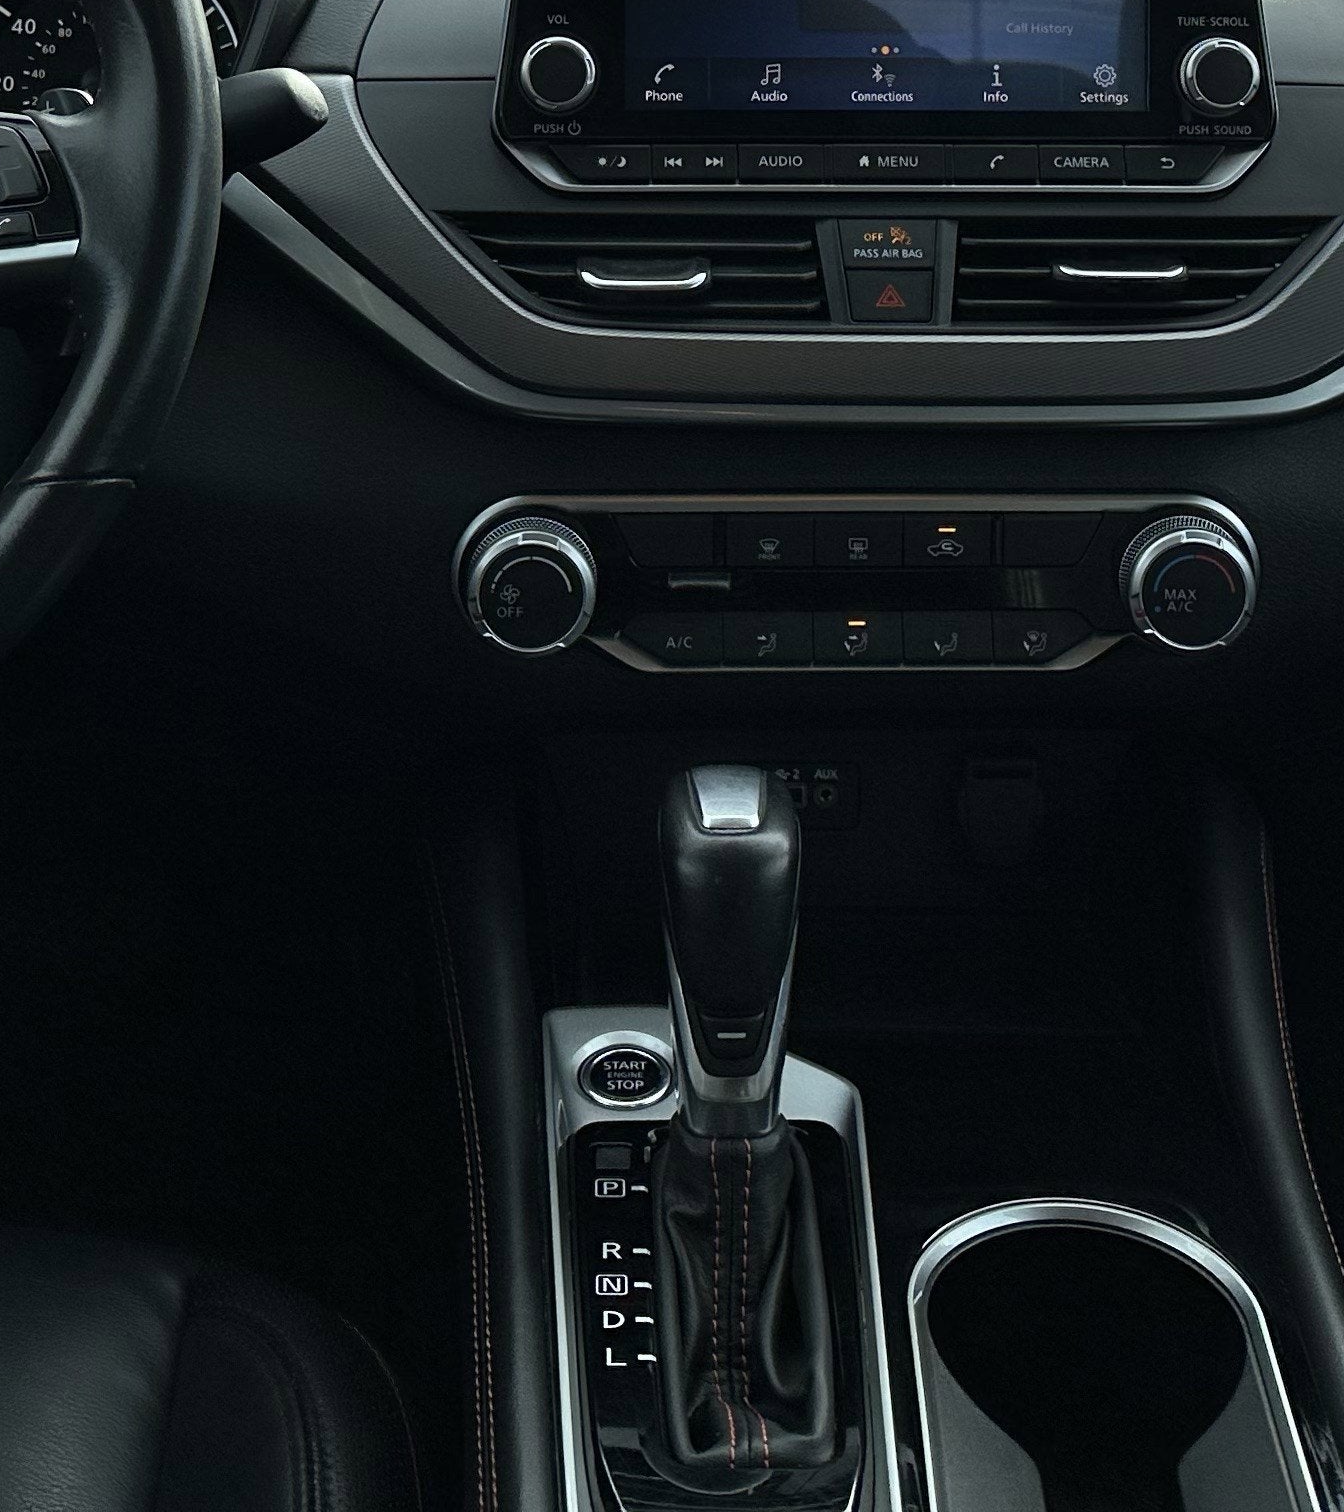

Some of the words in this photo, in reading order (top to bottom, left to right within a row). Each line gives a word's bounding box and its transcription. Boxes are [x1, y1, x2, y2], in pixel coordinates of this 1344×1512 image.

[547, 14, 570, 26] VOL
[10, 18, 37, 35] 40
[57, 27, 73, 38] 80
[1005, 22, 1031, 35] Call
[1033, 22, 1074, 37] History
[41, 44, 56, 54] 60
[31, 69, 45, 79] 40
[644, 90, 683, 103] Phone
[750, 90, 788, 103] Audio
[850, 90, 914, 104] Connections
[983, 91, 1009, 103] Info
[1079, 91, 1129, 106] Settings
[533, 122, 564, 134] PUSH
[1178, 125, 1209, 136] PUSH
[1213, 125, 1251, 136] SOUND
[757, 155, 803, 168] AUDIO
[877, 155, 919, 168] MENU
[1053, 156, 1109, 169] CAMERA
[863, 232, 884, 242] OFF
[853, 248, 879, 259] PASS
[881, 248, 900, 259] AIR
[901, 248, 923, 259] BAG
[1164, 588, 1198, 601] MAX
[496, 606, 524, 618] OFF
[1166, 601, 1194, 613] A/C
[665, 636, 693, 649] A/C
[603, 1060, 648, 1071] START
[607, 1071, 644, 1079] ENGINE
[607, 1079, 645, 1091] STOP
[602, 1182, 620, 1194] P
[602, 1242, 623, 1259] R
[602, 1277, 622, 1292] N
[603, 1311, 626, 1329] D
[605, 1348, 628, 1367] L
